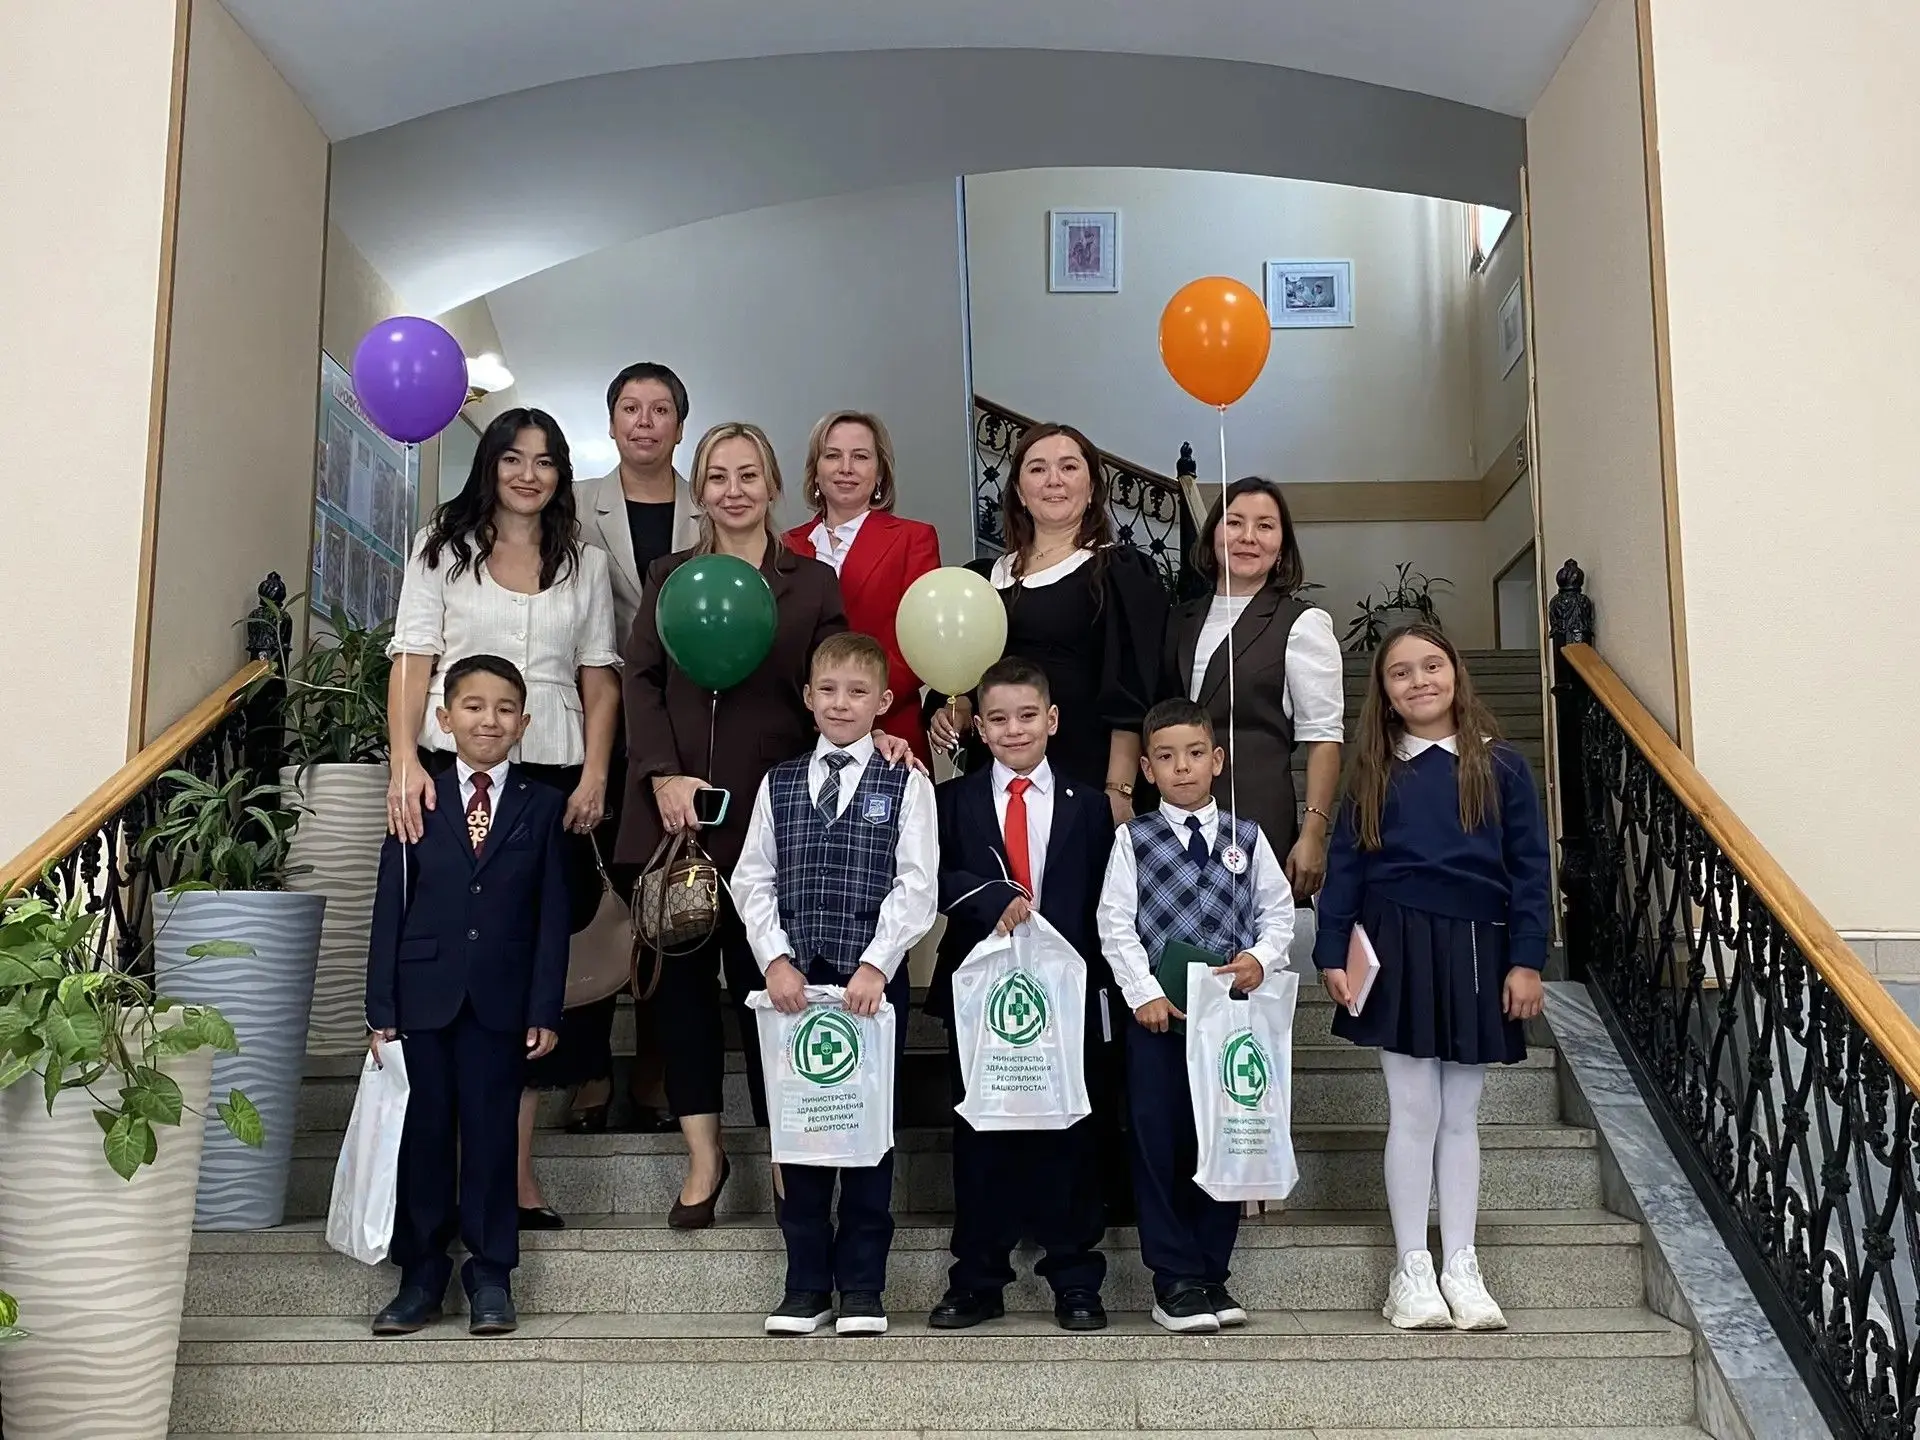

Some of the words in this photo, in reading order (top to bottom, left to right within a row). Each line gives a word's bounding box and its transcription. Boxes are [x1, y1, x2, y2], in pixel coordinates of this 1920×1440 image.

[992, 1055, 1045, 1063] МИНИСТЕРСТВО
[985, 1064, 1052, 1072] ЗДРАВООХРАНЕНИЯ
[996, 1074, 1042, 1082] РЕСПУБЛИКИ
[801, 1092, 857, 1104] МИНИСТЕРСТВО
[796, 1101, 864, 1114] ЗДРАВООХРАНЕНИЯ
[807, 1112, 854, 1123] РЕСПУБЛИКИ
[803, 1122, 859, 1133] БАШКОРТОСТАН
